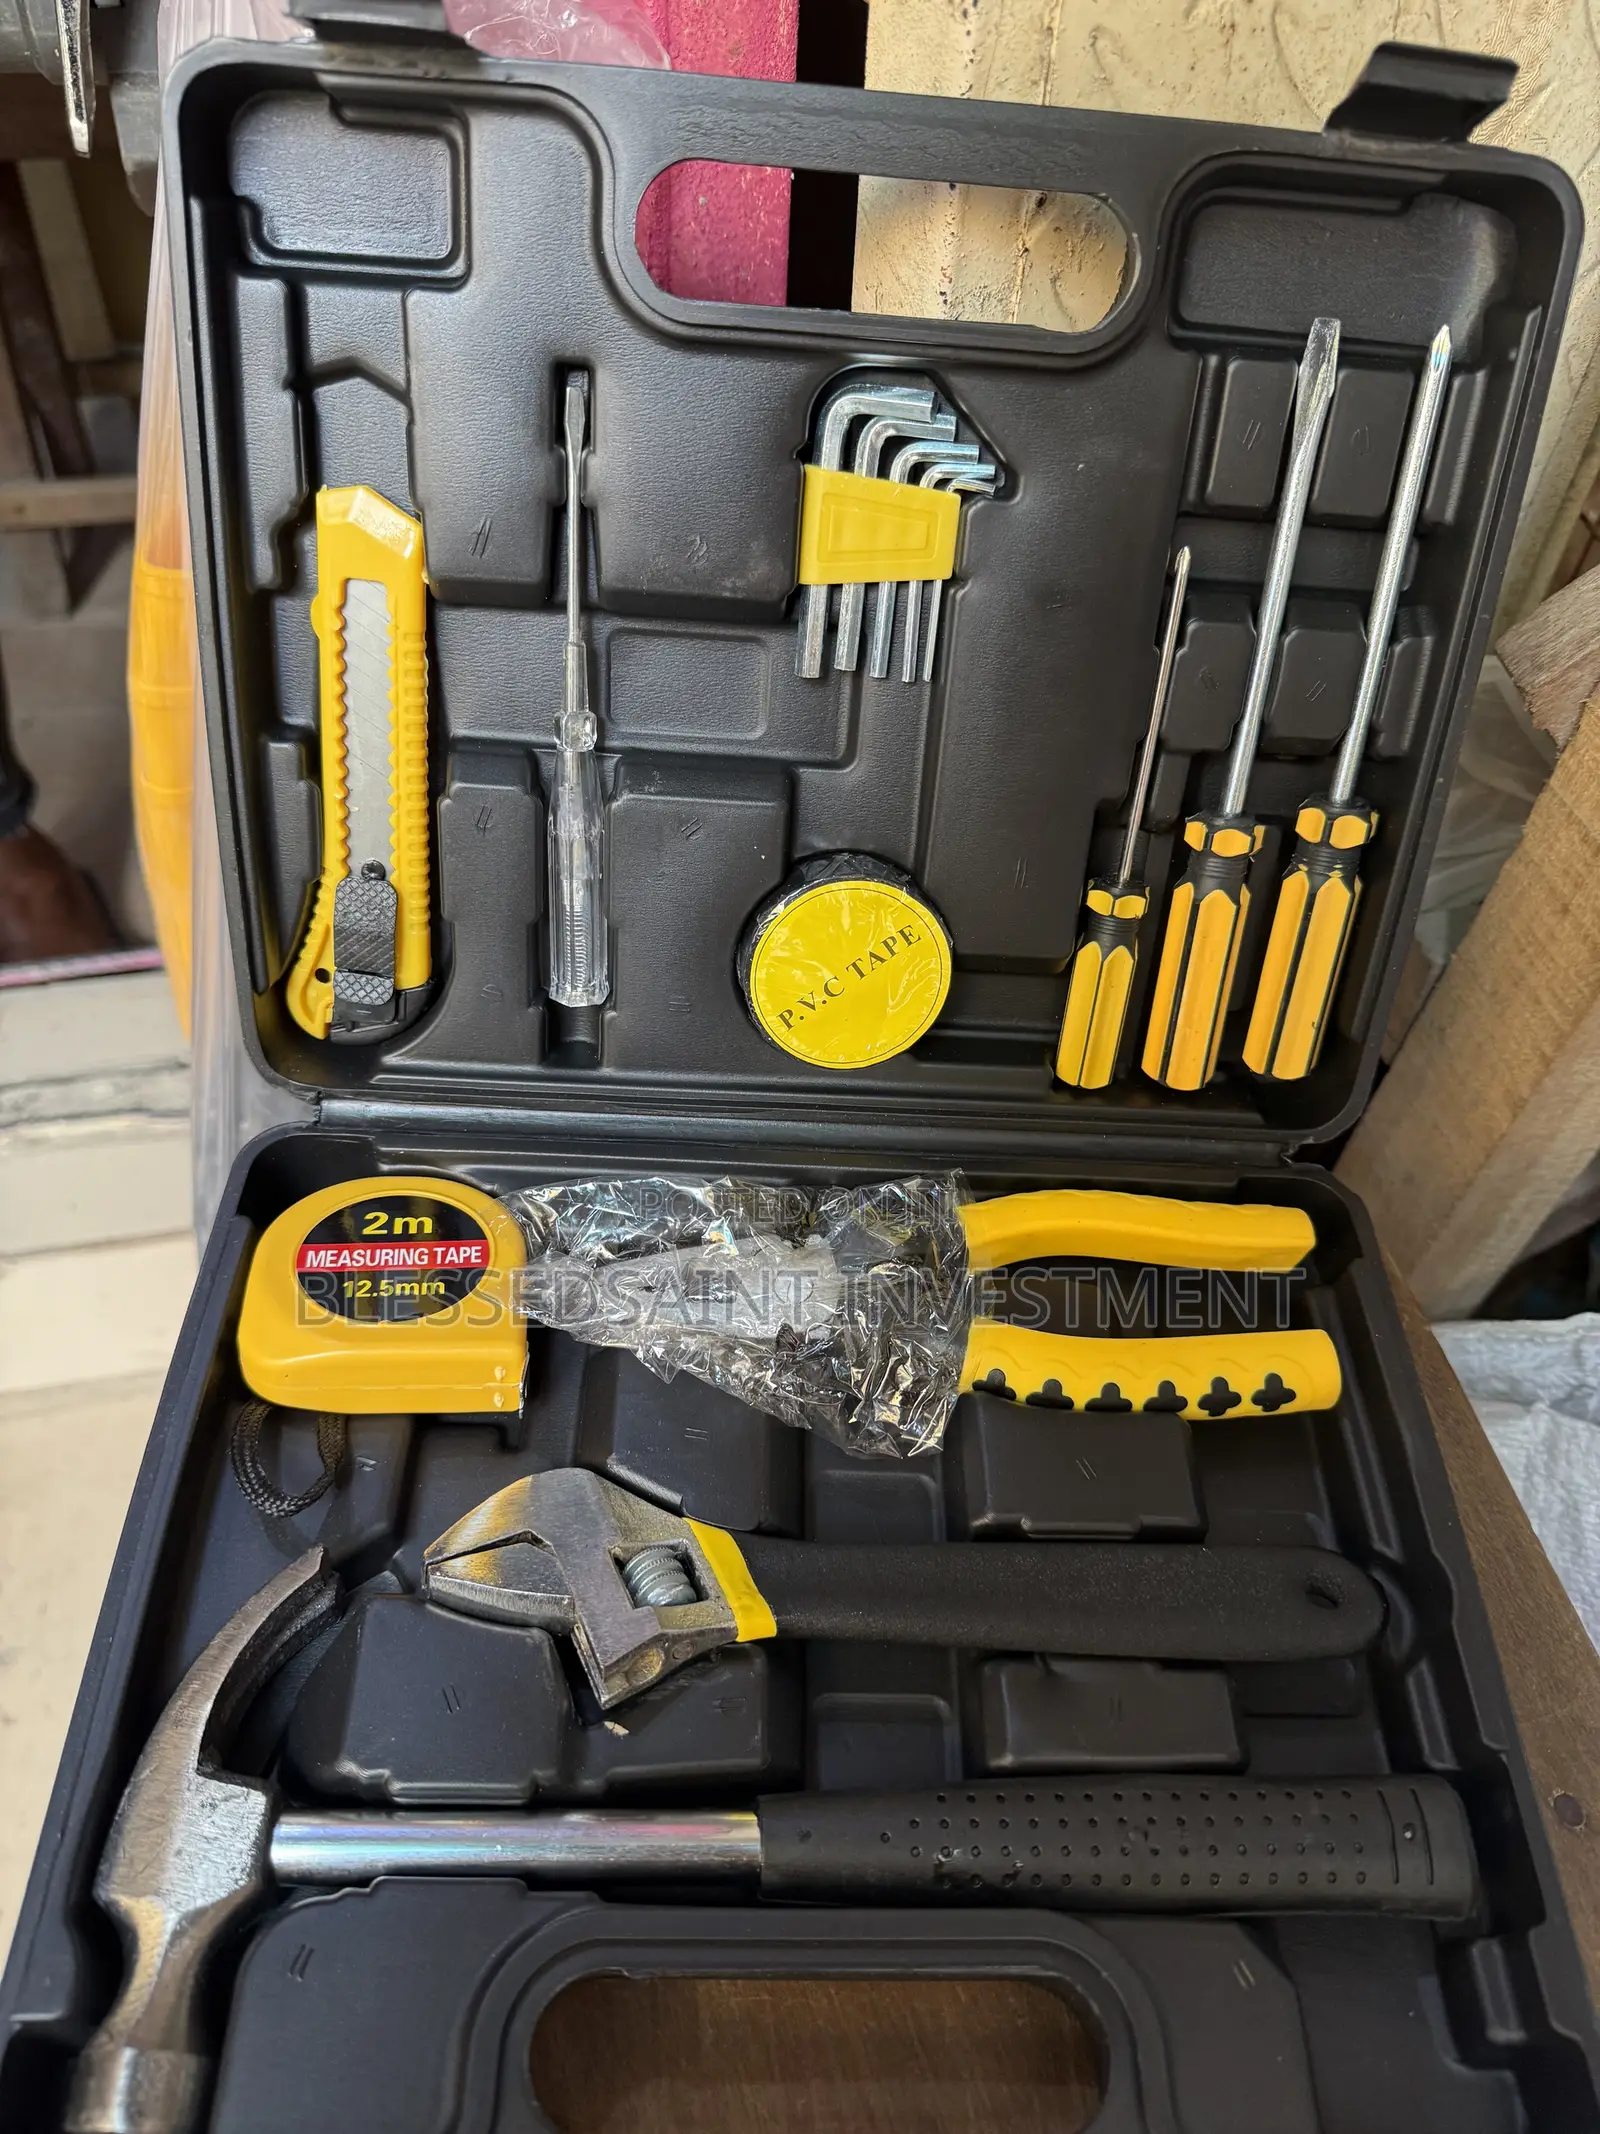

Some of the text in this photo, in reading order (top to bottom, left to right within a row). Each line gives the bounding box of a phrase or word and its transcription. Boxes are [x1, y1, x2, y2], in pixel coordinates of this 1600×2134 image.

[776, 924, 922, 1032] P.V.C TAPE
[362, 1211, 433, 1235] 2m
[305, 1246, 482, 1268] MEASURING TAPE
[343, 1280, 445, 1298] 12.5mm
